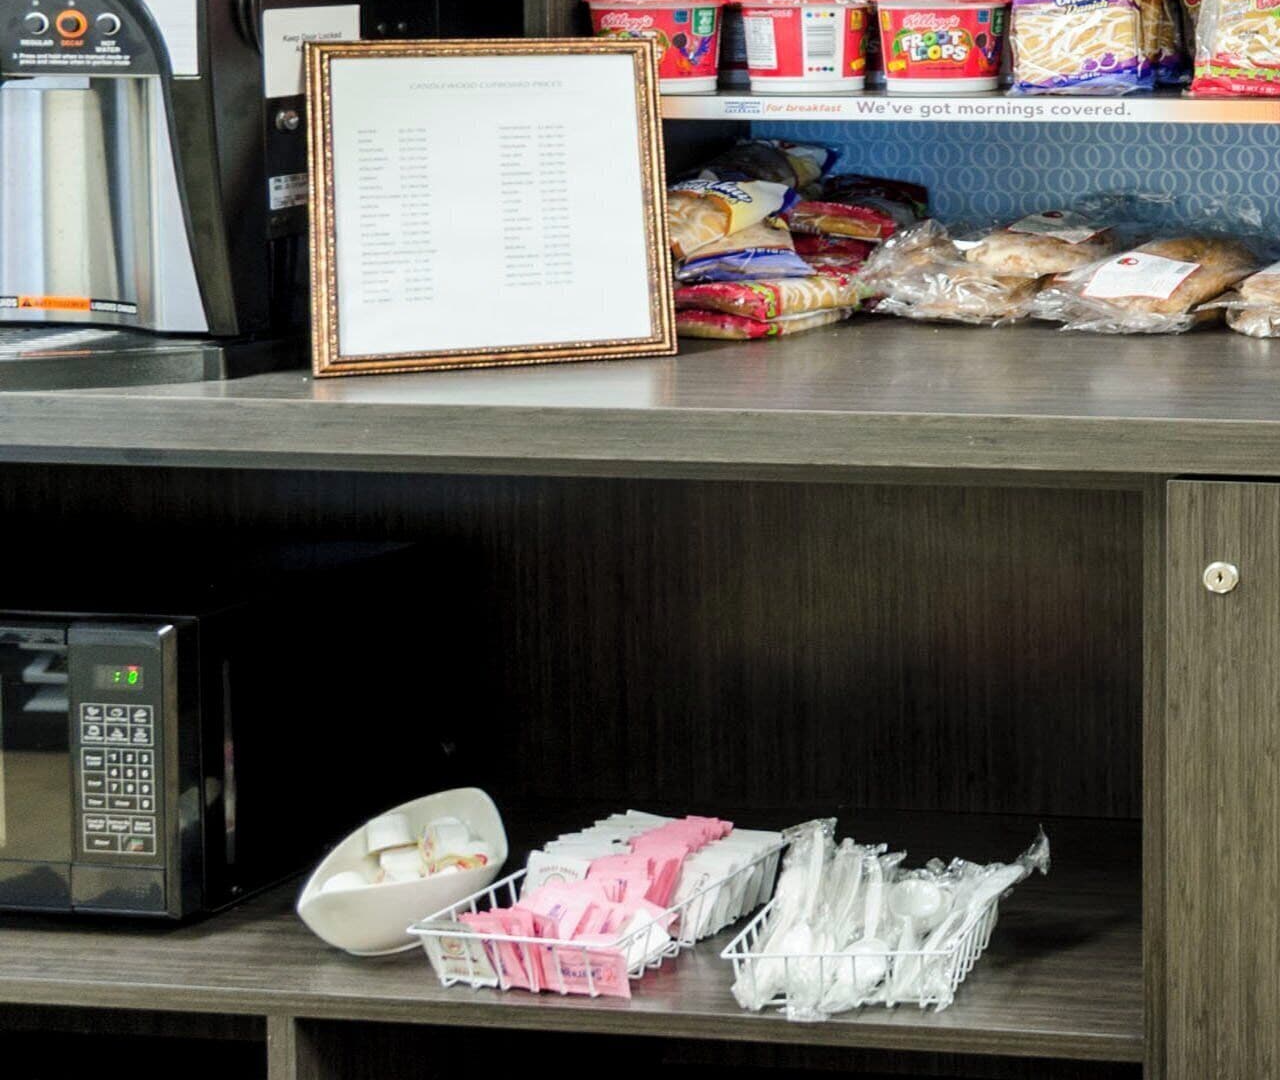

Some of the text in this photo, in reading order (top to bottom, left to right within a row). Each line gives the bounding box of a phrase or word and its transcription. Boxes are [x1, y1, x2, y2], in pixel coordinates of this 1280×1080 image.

[282, 31, 342, 43] Keep Door Locked
[856, 101, 1132, 119] We've got mornings covered.
